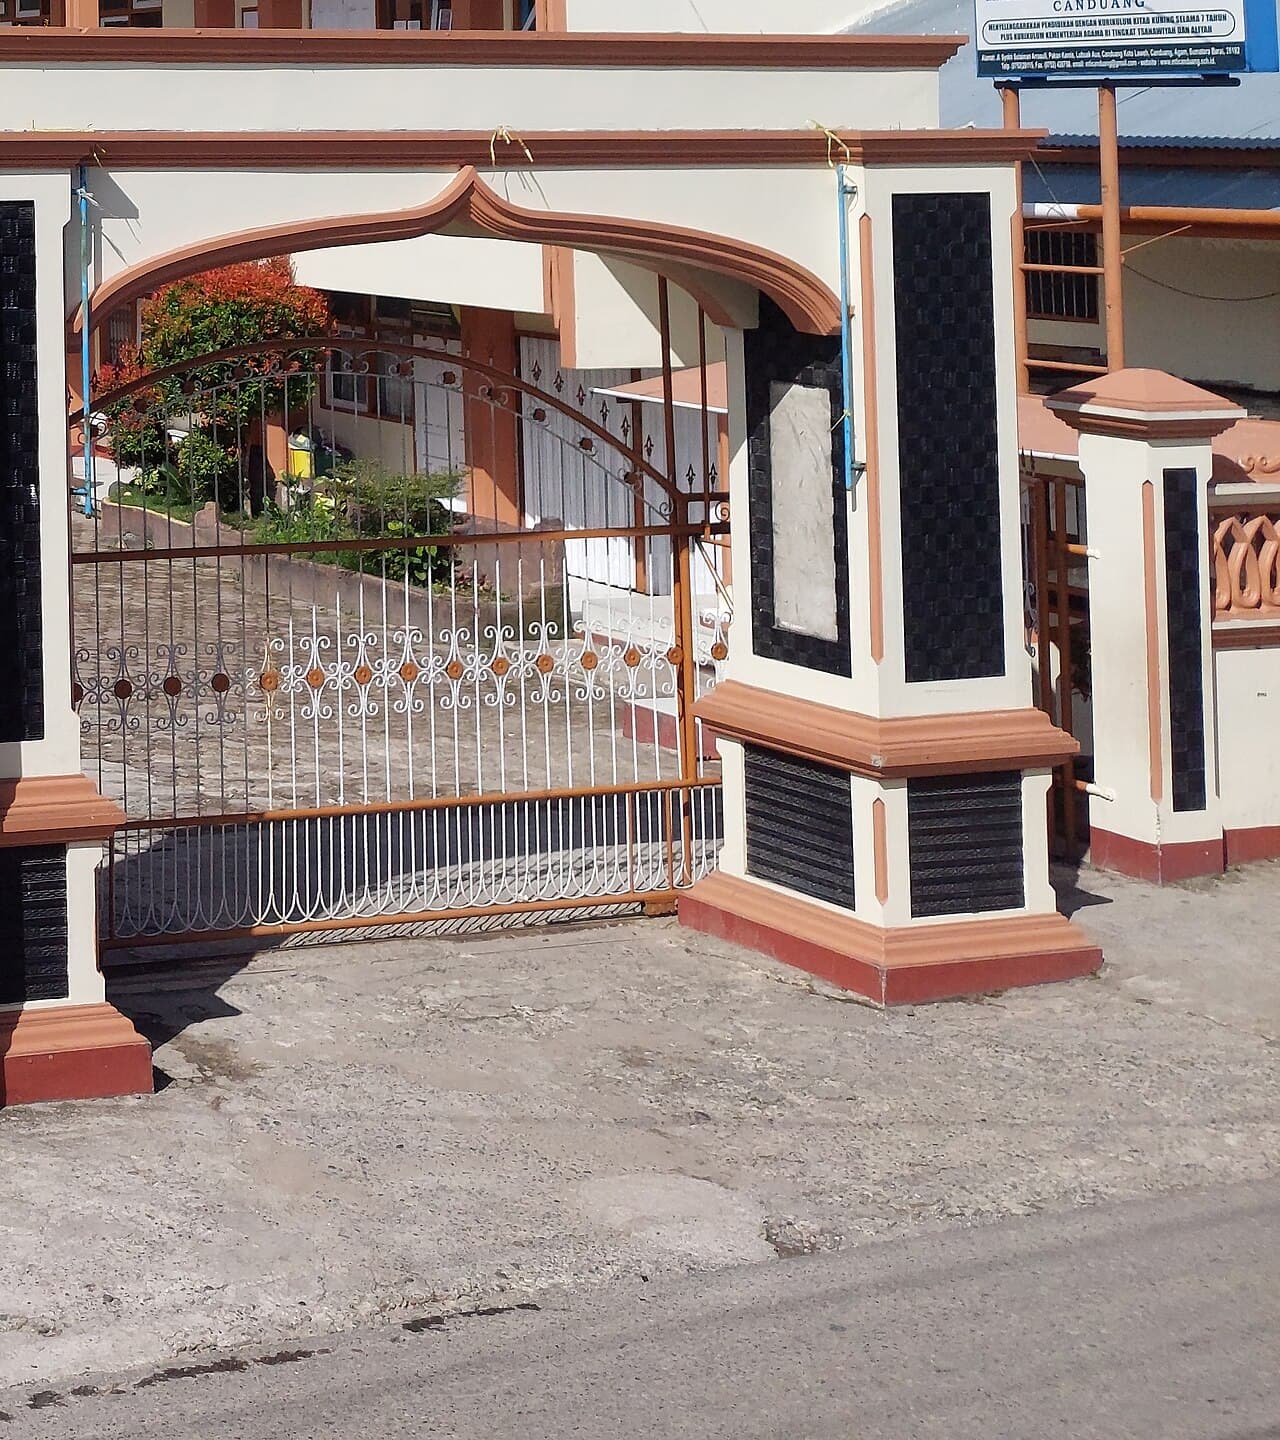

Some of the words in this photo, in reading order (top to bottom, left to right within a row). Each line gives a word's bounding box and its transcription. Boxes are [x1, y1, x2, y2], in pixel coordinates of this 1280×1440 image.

[1176, 15, 1200, 23] SELAMA
[1083, 29, 1104, 37] AGAMA
[1112, 28, 1136, 36] TINGKAT
[1177, 26, 1190, 34] DAN
